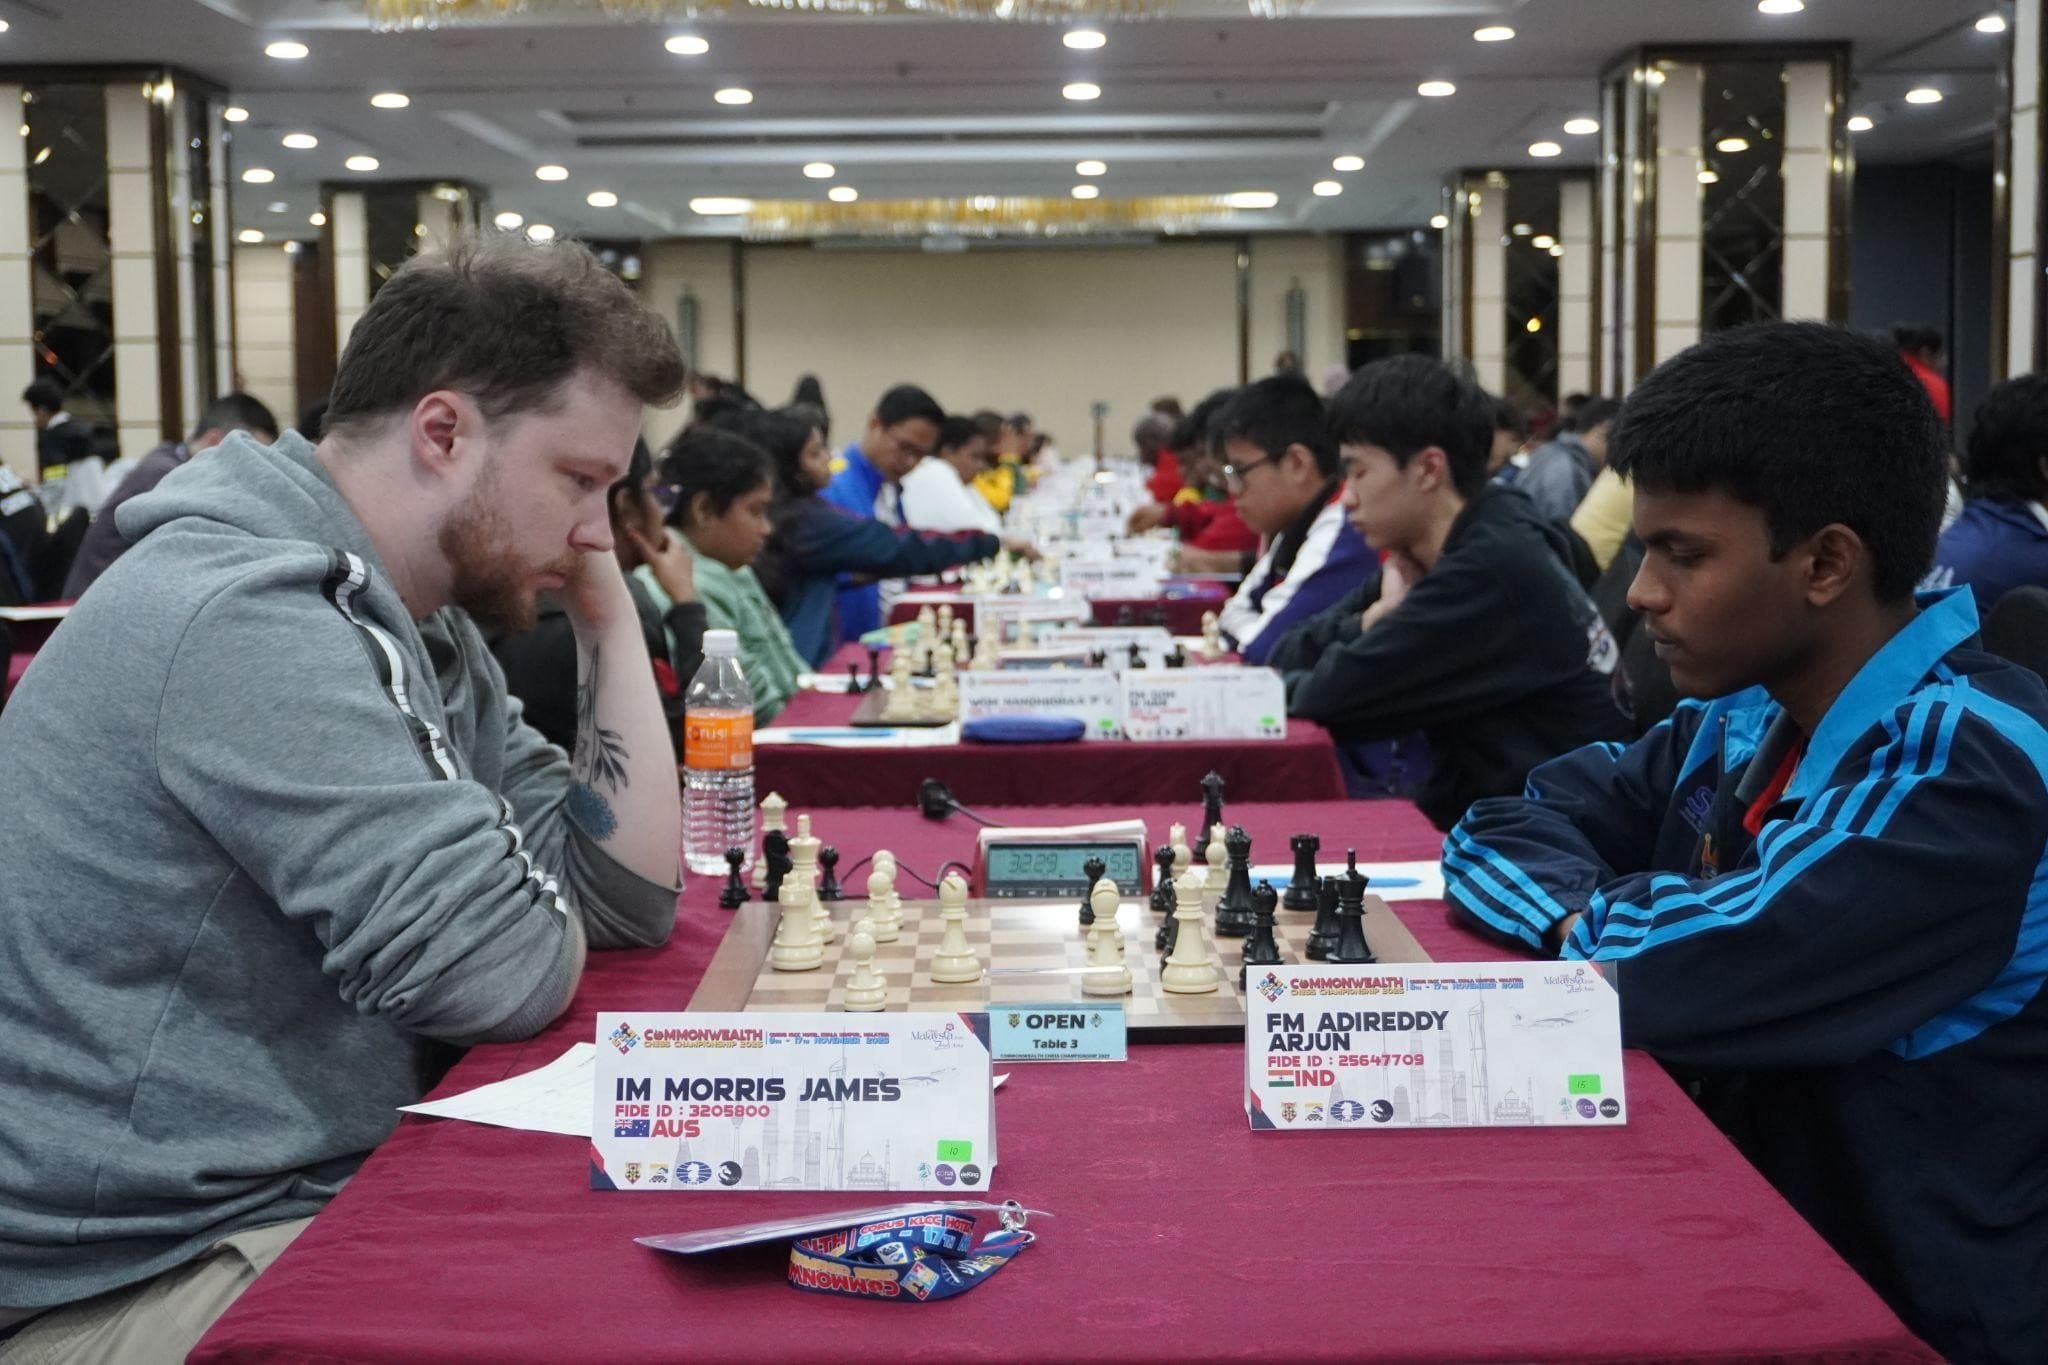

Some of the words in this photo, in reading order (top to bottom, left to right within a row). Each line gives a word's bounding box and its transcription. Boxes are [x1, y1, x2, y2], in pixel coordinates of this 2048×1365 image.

[1290, 976, 1404, 990] COMMONWEALTH
[1025, 1014, 1086, 1030] OPEN
[1266, 1012, 1305, 1033] FM
[1317, 1010, 1450, 1032] ADIREDDY
[643, 1028, 763, 1041] COMMONWEALTH
[1268, 1032, 1351, 1052] ARJUN
[674, 1040, 738, 1048] CHAMPIONSHIP
[1032, 1039, 1068, 1049] Table
[1070, 1039, 1078, 1049] 3
[1267, 1055, 1301, 1068] FIDE
[1307, 1055, 1323, 1067] ID
[1338, 1053, 1425, 1067] 25647709
[1294, 1069, 1336, 1087] IND
[615, 1077, 651, 1101] IM
[664, 1077, 786, 1102] MORRIS
[799, 1077, 901, 1102] JAMES
[614, 1104, 650, 1118] FIDE
[656, 1104, 673, 1117] ID
[688, 1104, 771, 1118] 3205800
[650, 1119, 701, 1138] AUS
[859, 1219, 906, 1235] CORUS
